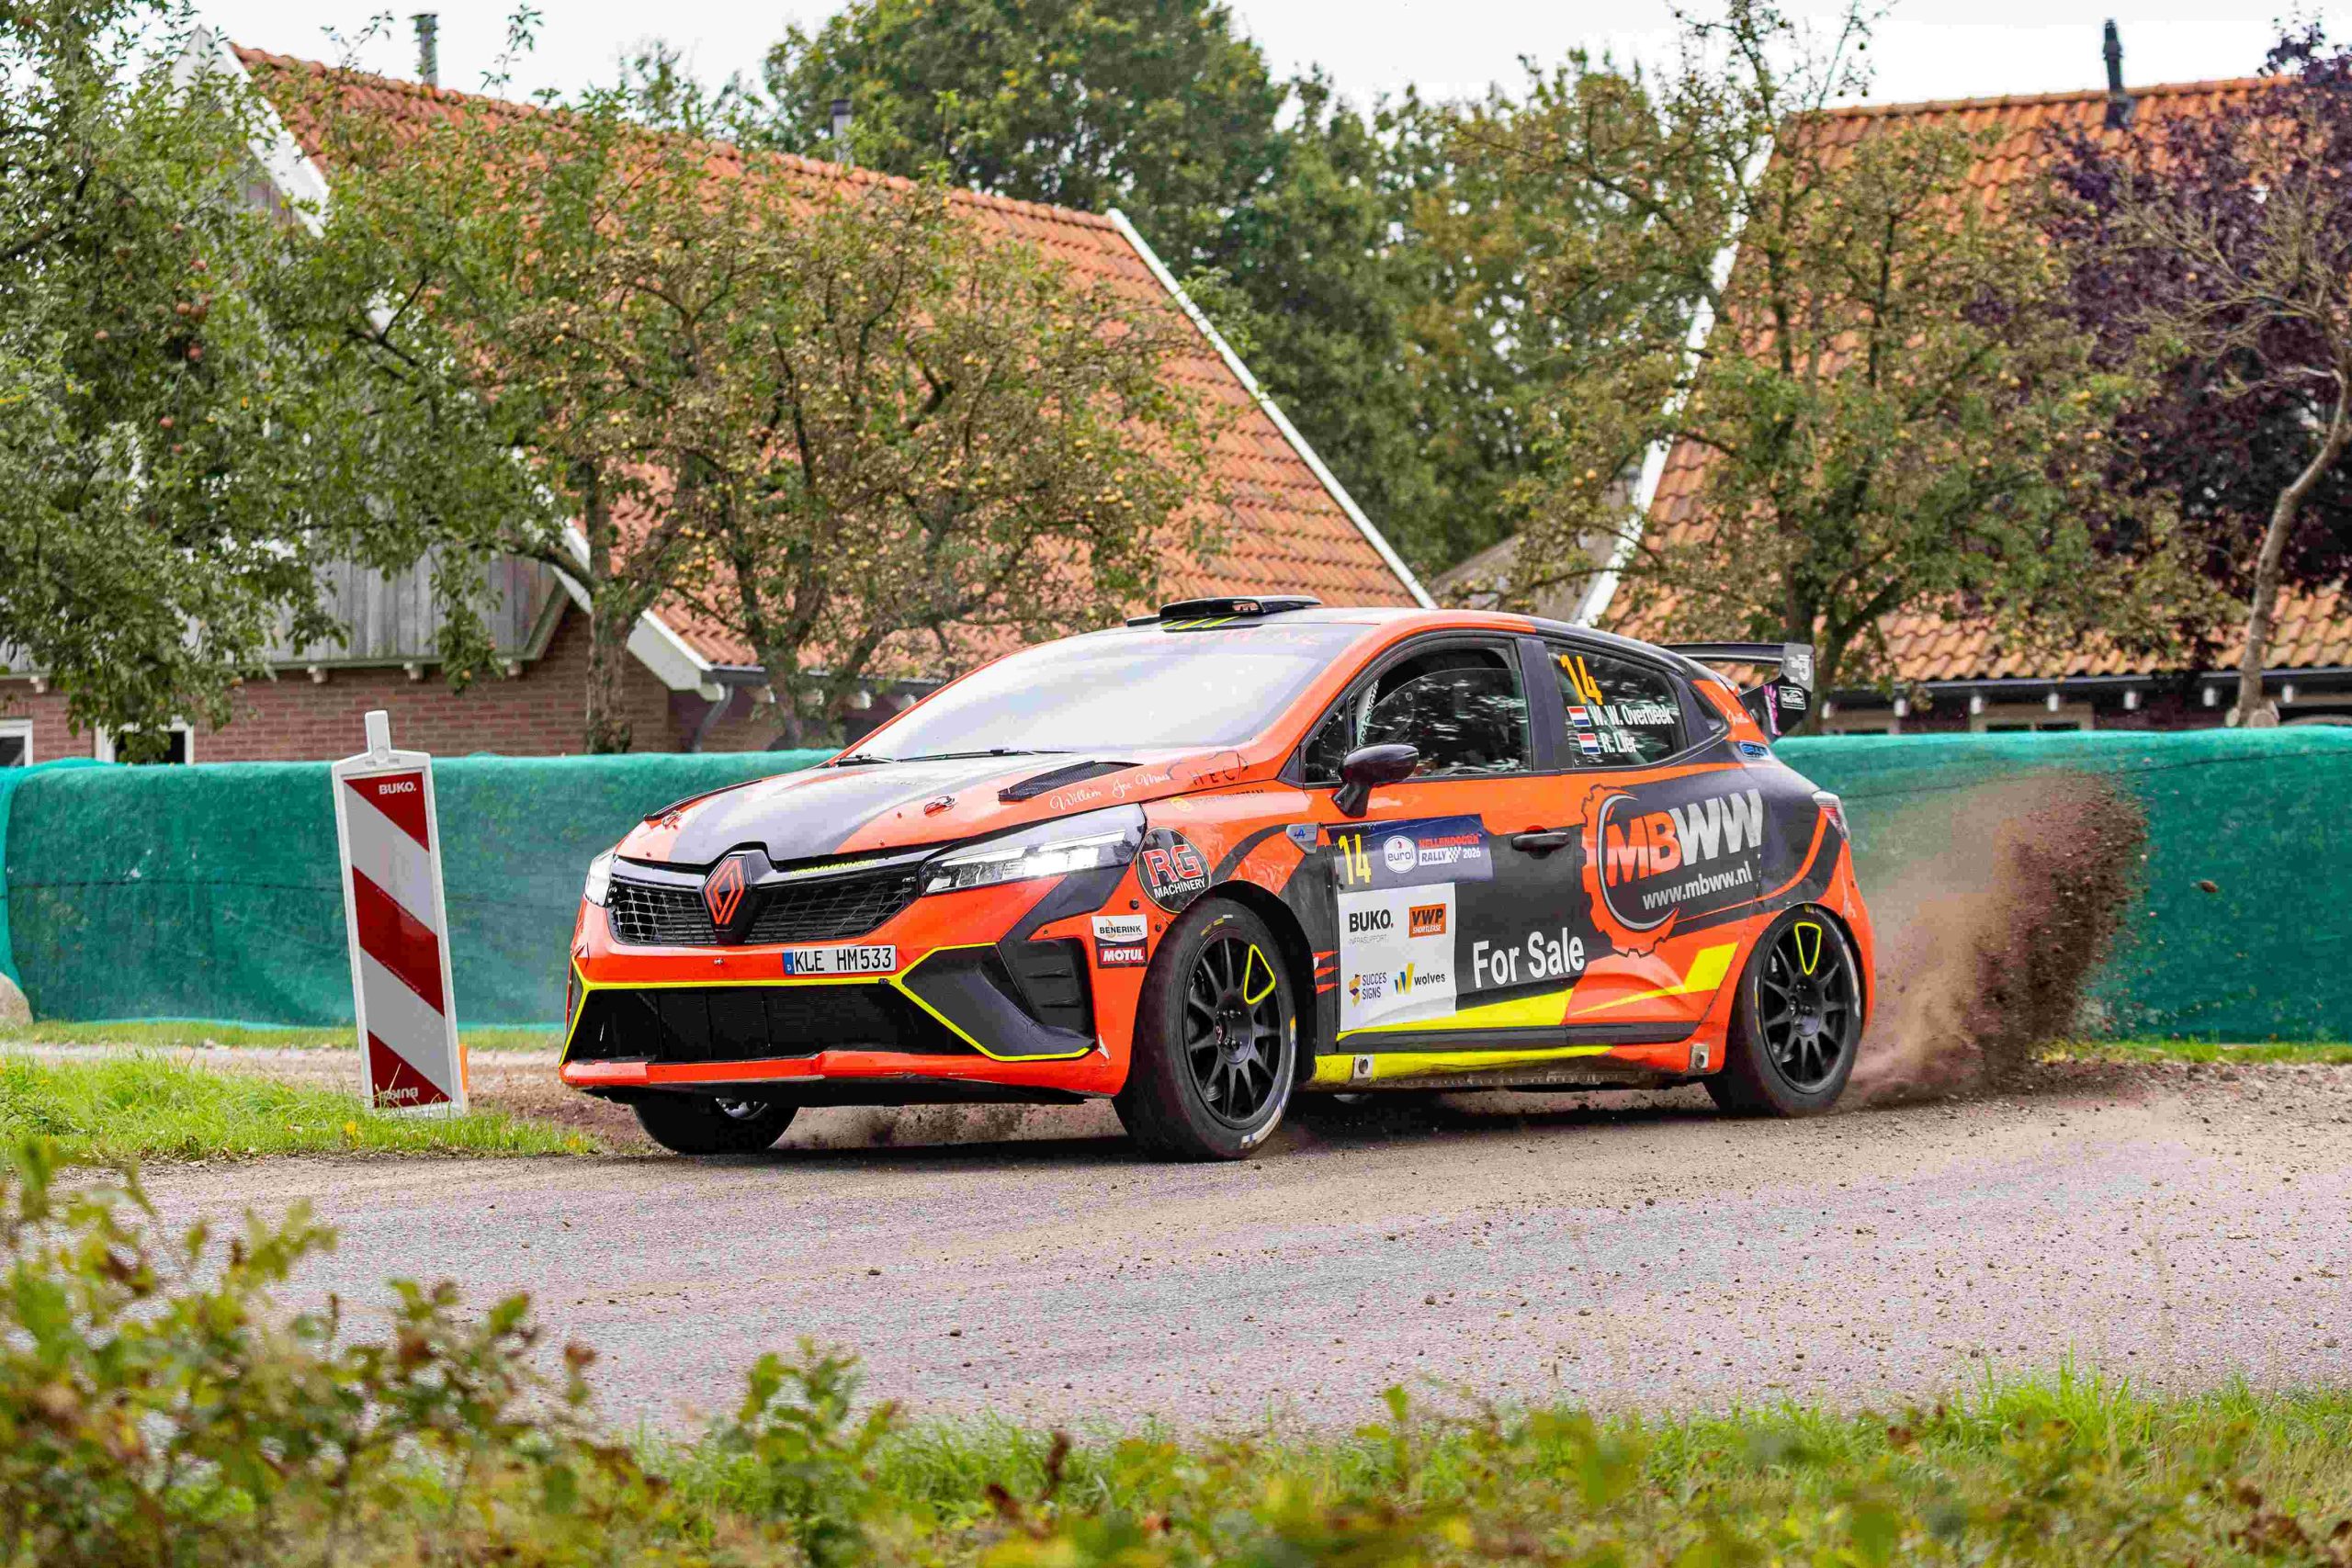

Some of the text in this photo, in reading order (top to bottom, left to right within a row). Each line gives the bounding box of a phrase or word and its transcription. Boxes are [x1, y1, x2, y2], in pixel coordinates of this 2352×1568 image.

[1560, 654, 1603, 705] 14
[1588, 704, 1675, 726] W. W. Overbeek
[1600, 732, 1637, 753] R. Lier
[379, 782, 416, 795] BUKO.
[1049, 788, 1102, 810] Willem
[1606, 788, 1763, 887] MBWW
[1142, 843, 1204, 887] RG
[1339, 834, 1371, 885] 14
[1387, 848, 1414, 862] eurol
[1421, 847, 1481, 863] RALLY 2026
[1153, 877, 1206, 899] MACHINERY
[1643, 861, 1753, 909] www.mbww.nl
[1349, 908, 1394, 932] BUKO.
[1411, 908, 1443, 926] VWP
[1100, 925, 1142, 934] BENERINK
[794, 950, 825, 972] KLE
[1102, 949, 1144, 962] MOTUL
[1473, 927, 1585, 989] For Sale
[1362, 972, 1387, 986] SUCCES
[1414, 973, 1445, 986] wolves
[1362, 987, 1382, 999] SIGNS
